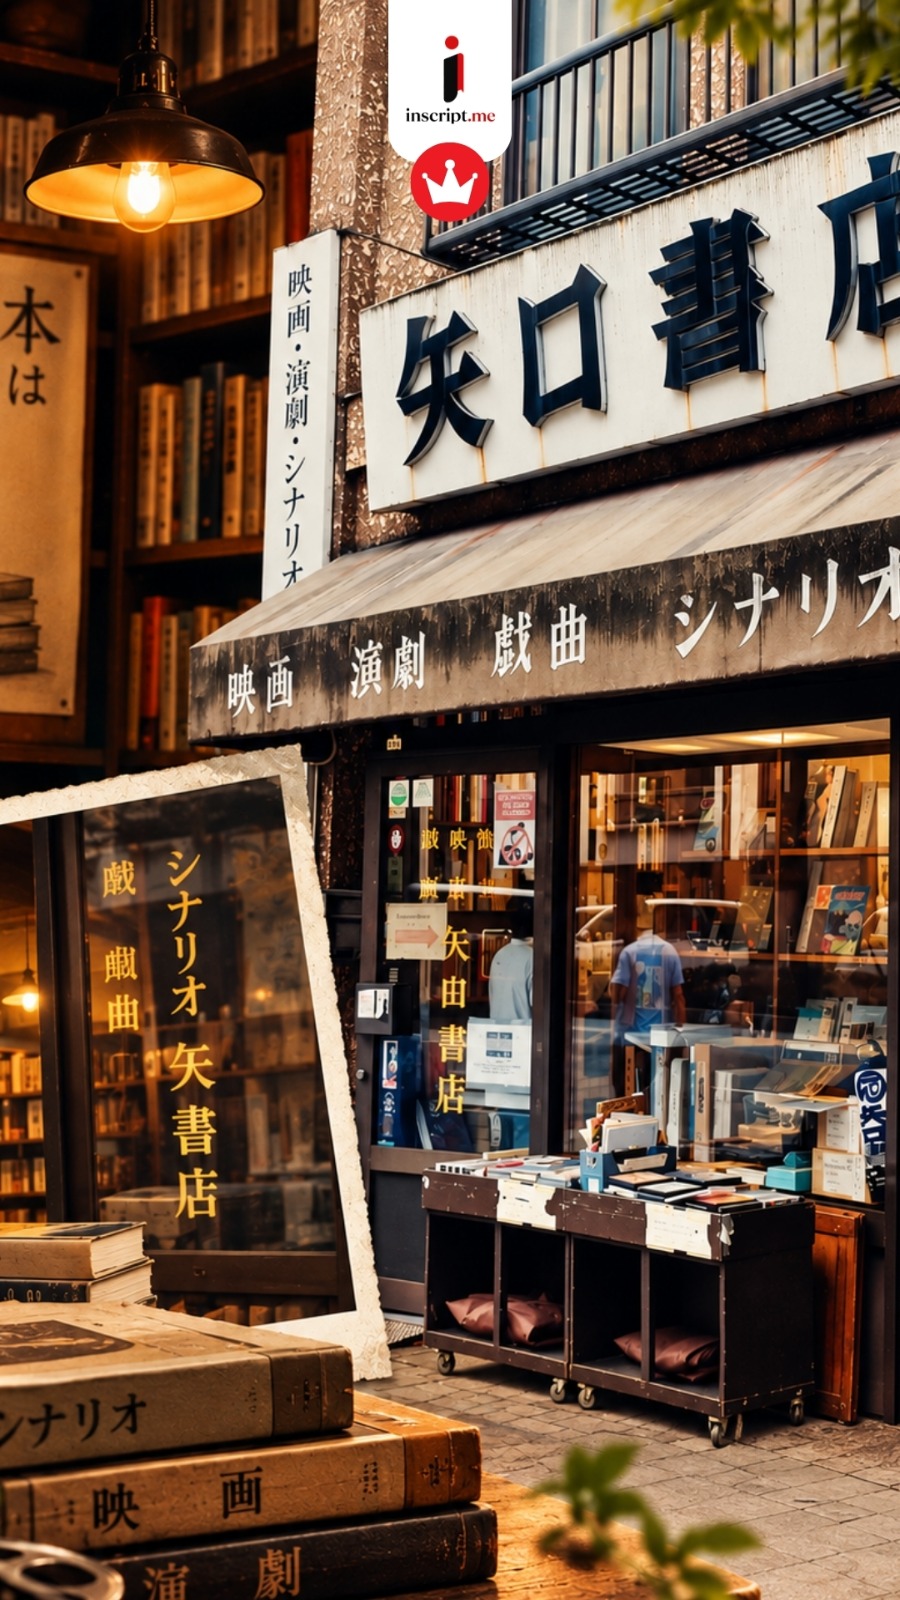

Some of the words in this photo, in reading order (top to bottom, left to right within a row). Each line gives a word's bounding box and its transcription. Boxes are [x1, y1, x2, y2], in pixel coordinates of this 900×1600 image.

[0, 285, 61, 405] 本は
[395, 151, 900, 467] 矢口書店
[227, 655, 293, 718] 映画
[350, 631, 426, 699] 演劇
[490, 603, 588, 678] 戯曲
[674, 546, 900, 660] シナリオ
[166, 850, 206, 1016] シナリオ
[169, 1041, 217, 1219] 矢書店
